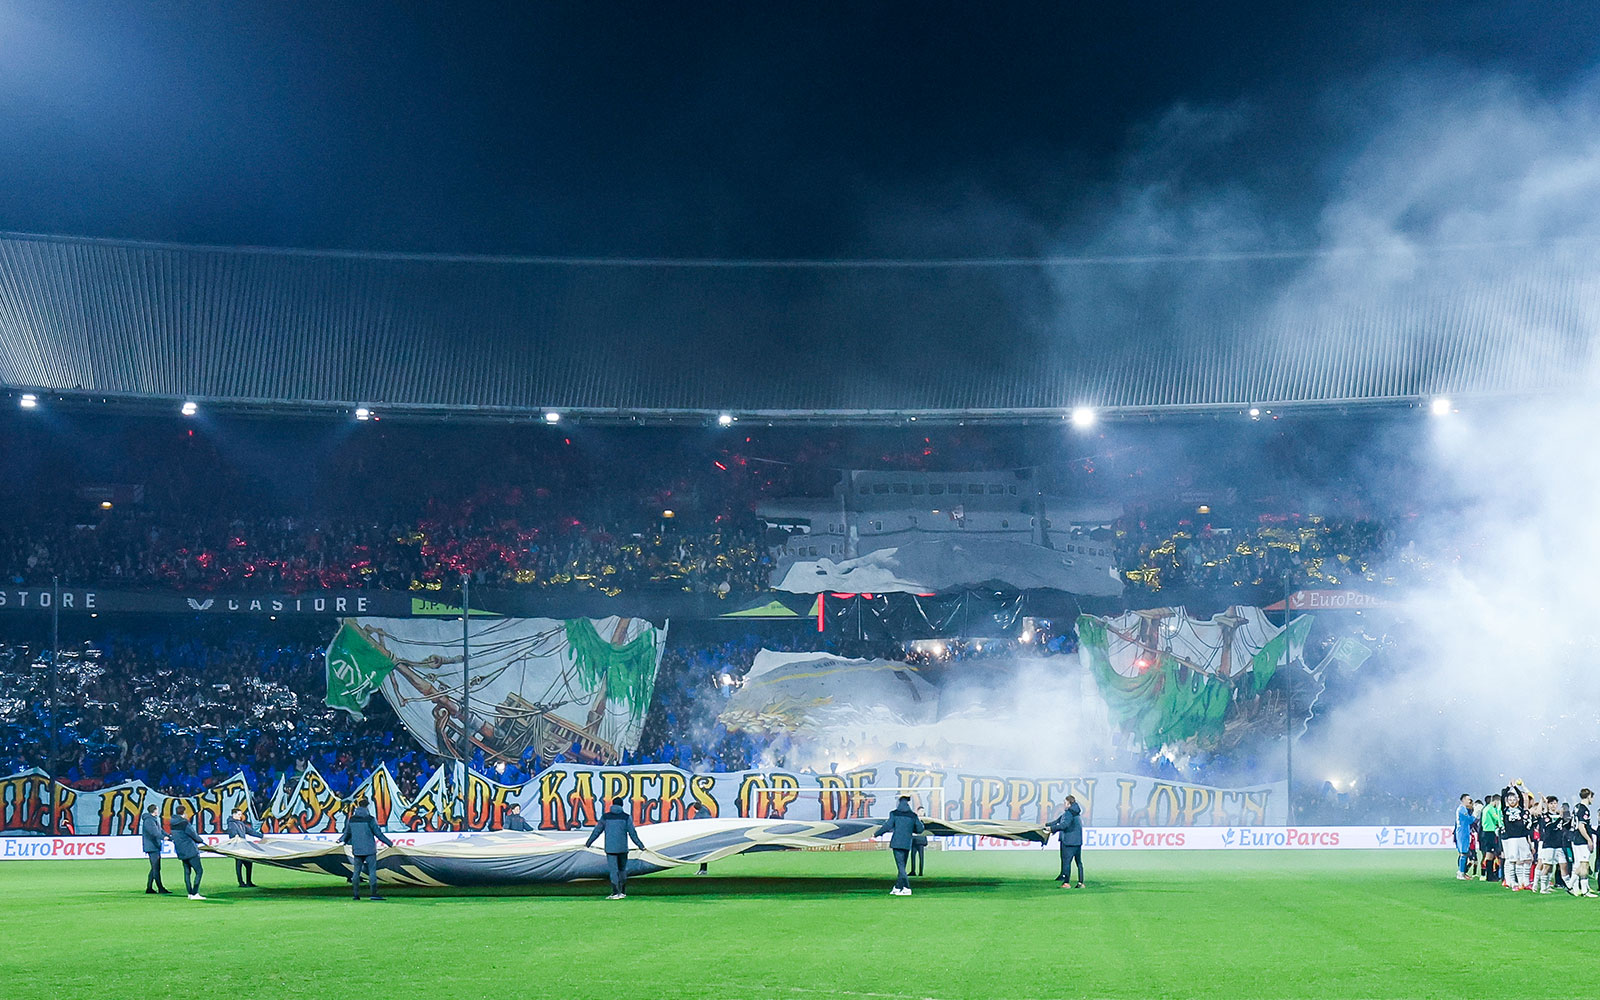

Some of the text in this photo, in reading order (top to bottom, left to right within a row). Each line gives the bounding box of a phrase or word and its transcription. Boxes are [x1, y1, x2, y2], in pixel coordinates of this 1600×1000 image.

[98, 787, 148, 835] IN
[538, 770, 719, 832] KAPERS
[735, 773, 799, 819] OP
[816, 768, 878, 821] DE
[895, 767, 1098, 827] KLIPPEN
[1117, 779, 1272, 827] LOPEN
[1085, 829, 1185, 847] EuroParcs
[1239, 828, 1340, 846] EuroParcs
[4, 839, 105, 857] EuroParcs
